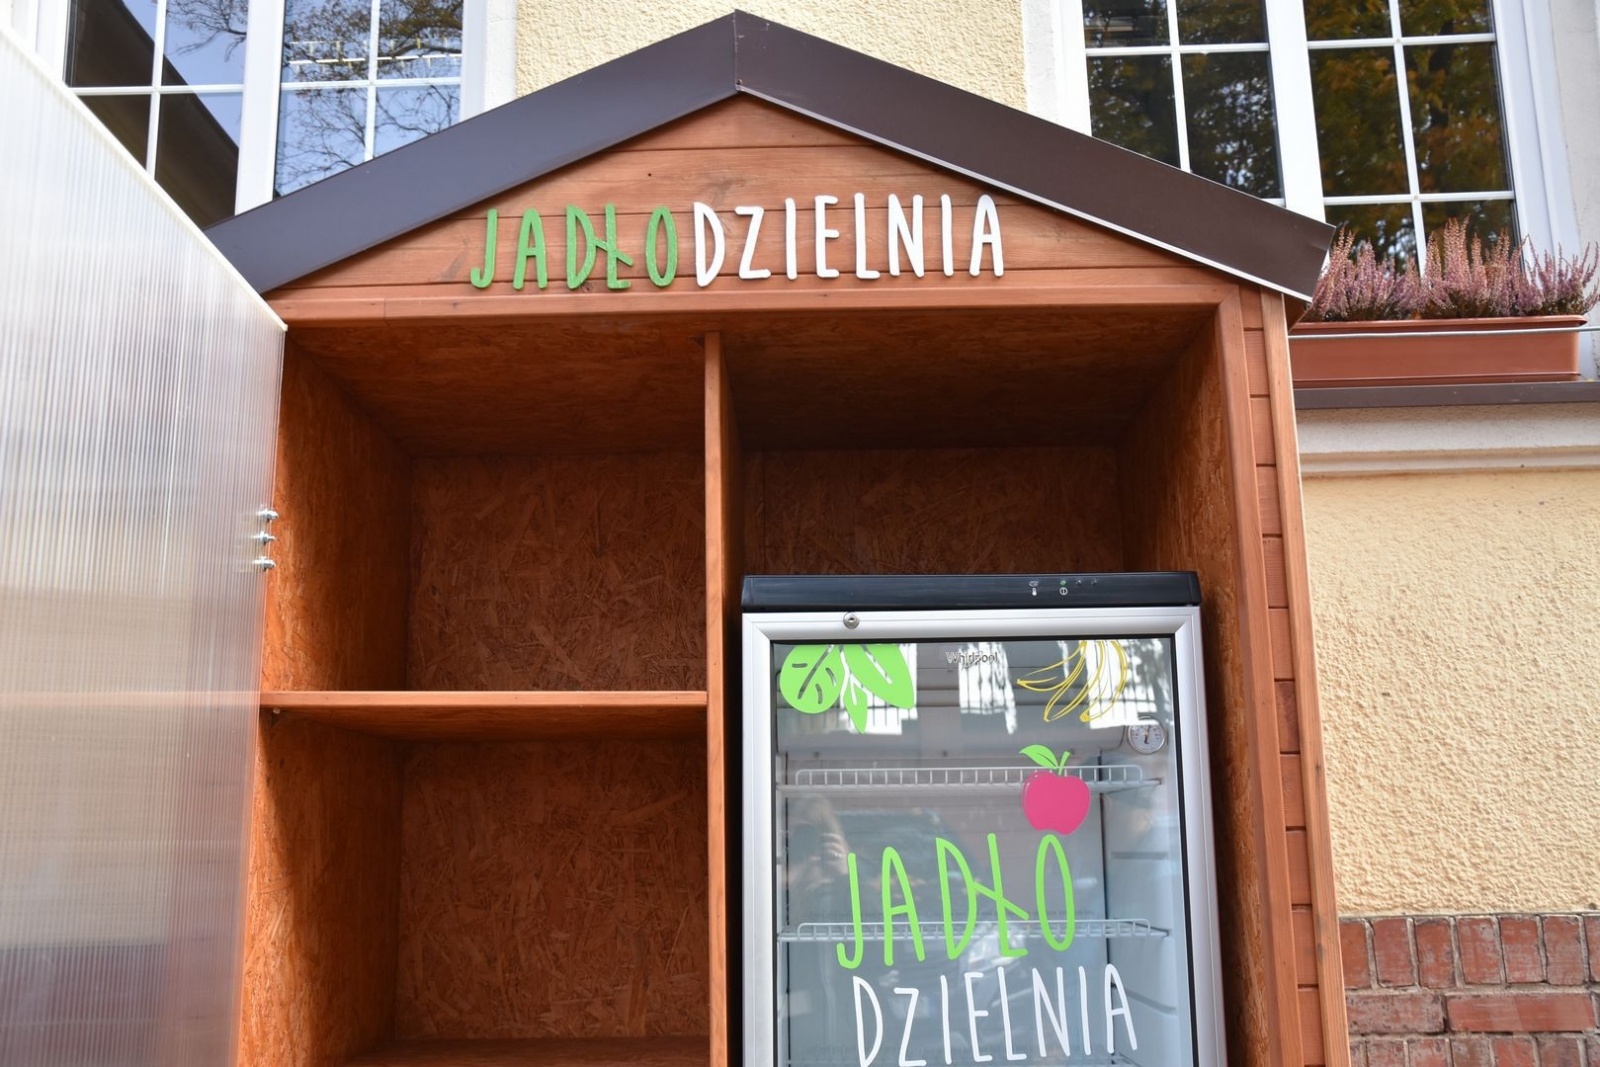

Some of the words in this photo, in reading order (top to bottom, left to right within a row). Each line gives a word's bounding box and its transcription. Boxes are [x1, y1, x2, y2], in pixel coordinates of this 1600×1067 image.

[470, 192, 1004, 290] JADŁODZIELNIA
[945, 651, 998, 667] Whirlpool
[837, 833, 1076, 969] JADŁO
[852, 963, 1138, 1067] DZIELNIA
